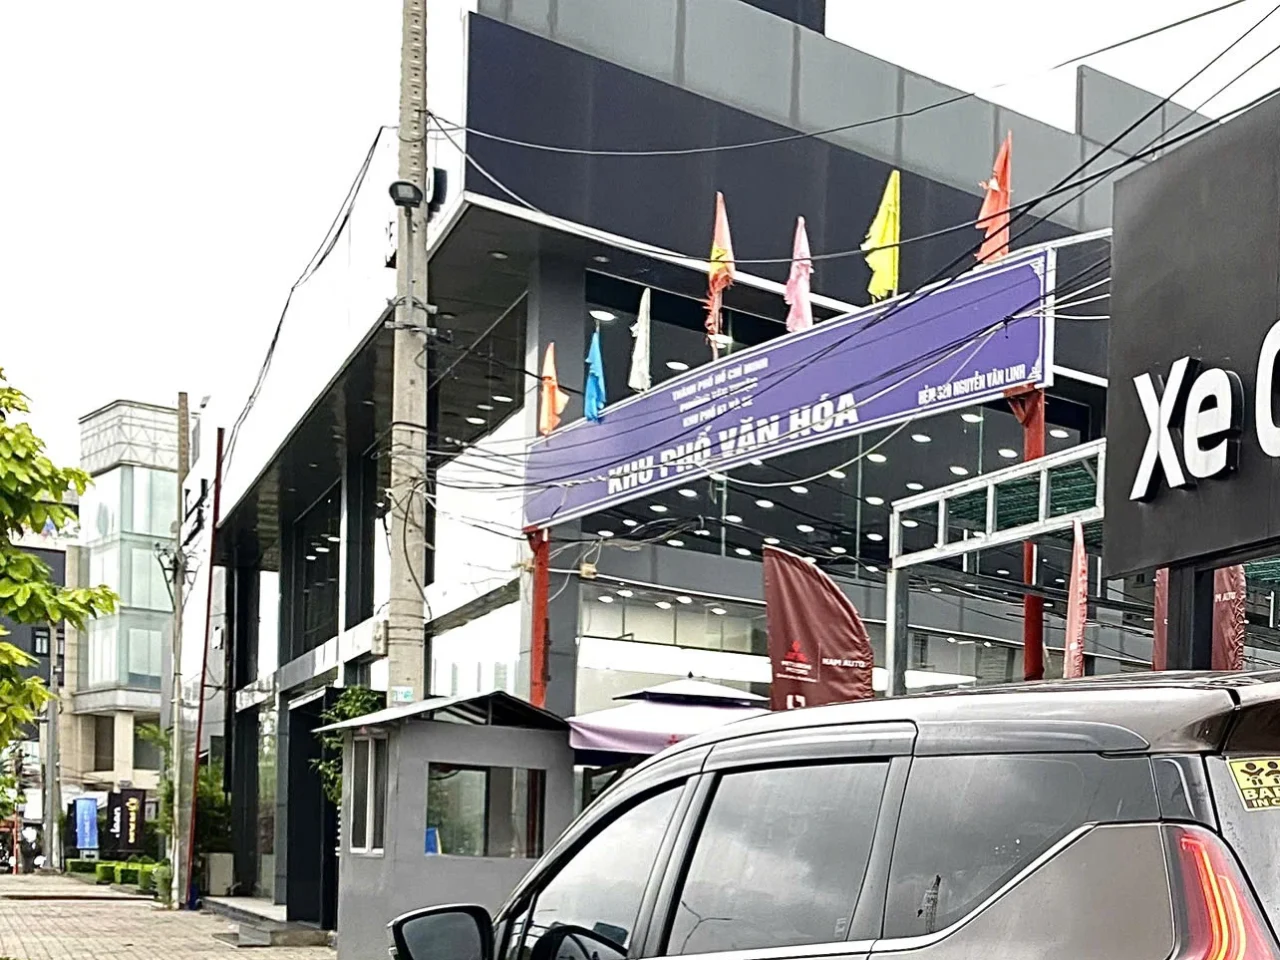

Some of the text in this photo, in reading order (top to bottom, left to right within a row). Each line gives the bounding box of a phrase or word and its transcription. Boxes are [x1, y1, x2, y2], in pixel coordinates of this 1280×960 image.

[1005, 363, 1026, 383] LINH
[607, 392, 860, 494] KHU PHỐ VĂN HÓA
[1129, 356, 1236, 501] Xe
[1251, 798, 1270, 808] IN
